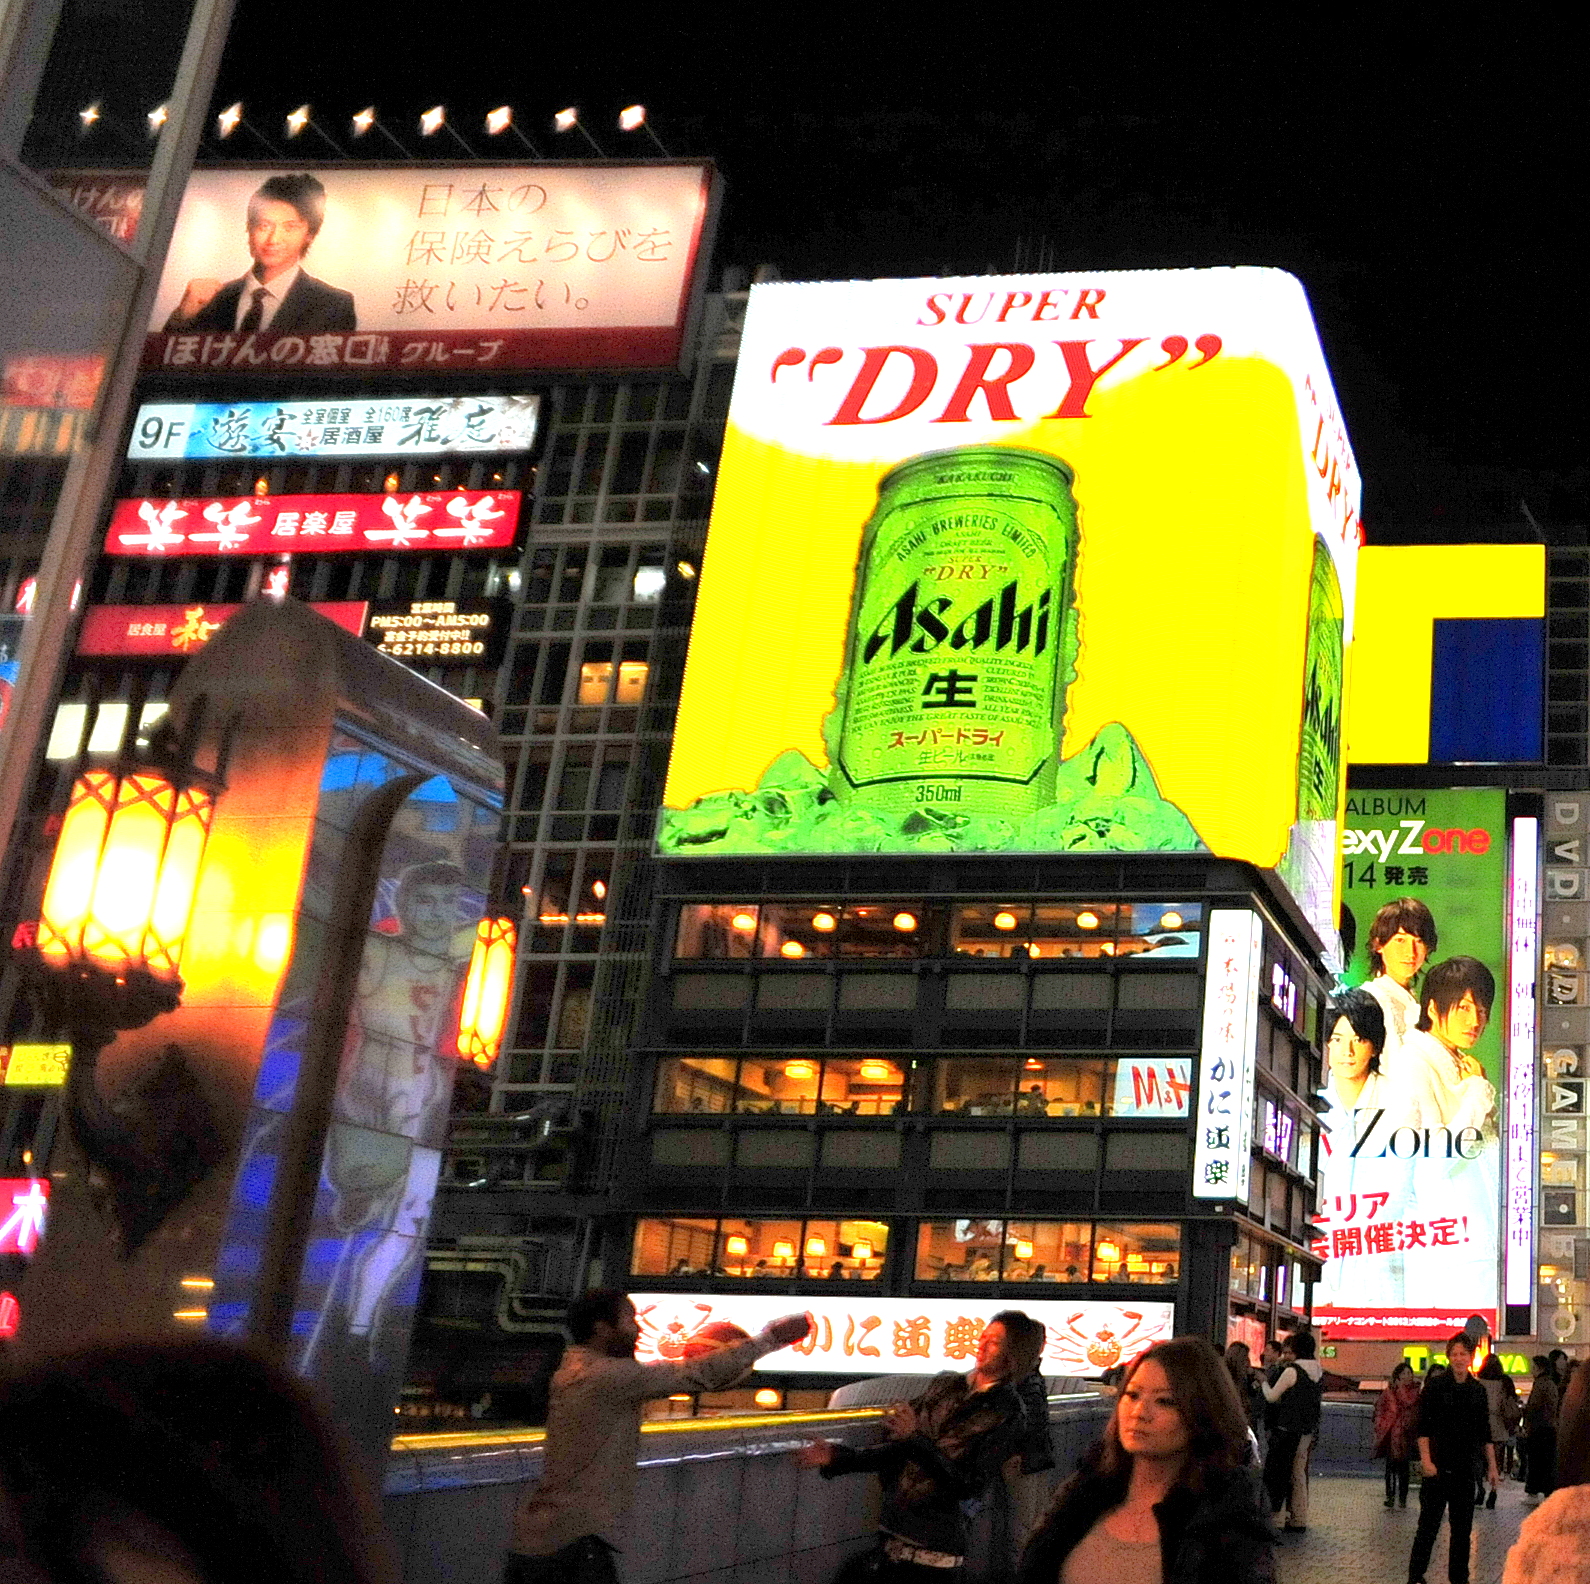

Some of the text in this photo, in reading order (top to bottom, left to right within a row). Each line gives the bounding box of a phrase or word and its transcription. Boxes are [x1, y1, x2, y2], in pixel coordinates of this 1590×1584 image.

[417, 182, 547, 218] 日本の
[404, 228, 674, 266] 保険えらびを
[392, 278, 591, 315] 救いたい。
[917, 288, 1106, 326] SUPER
[163, 333, 503, 366] ほけんの窓口 グループ
[138, 415, 186, 450] 9F
[319, 425, 385, 445] 居酒屋
[271, 511, 358, 536] 居楽屋
[896, 514, 1038, 561] ASAHI BREWERIES LIMITED
[864, 578, 1052, 665] Asahi
[921, 669, 979, 709] 生
[888, 728, 1005, 749] スーパードライ
[918, 750, 967, 765] 生ビール
[915, 784, 962, 803] 350ml
[1345, 797, 1427, 815] ALBUM
[1554, 802, 1580, 896] DVD
[1384, 866, 1429, 886] 発売
[1349, 1108, 1484, 1160] Zone
